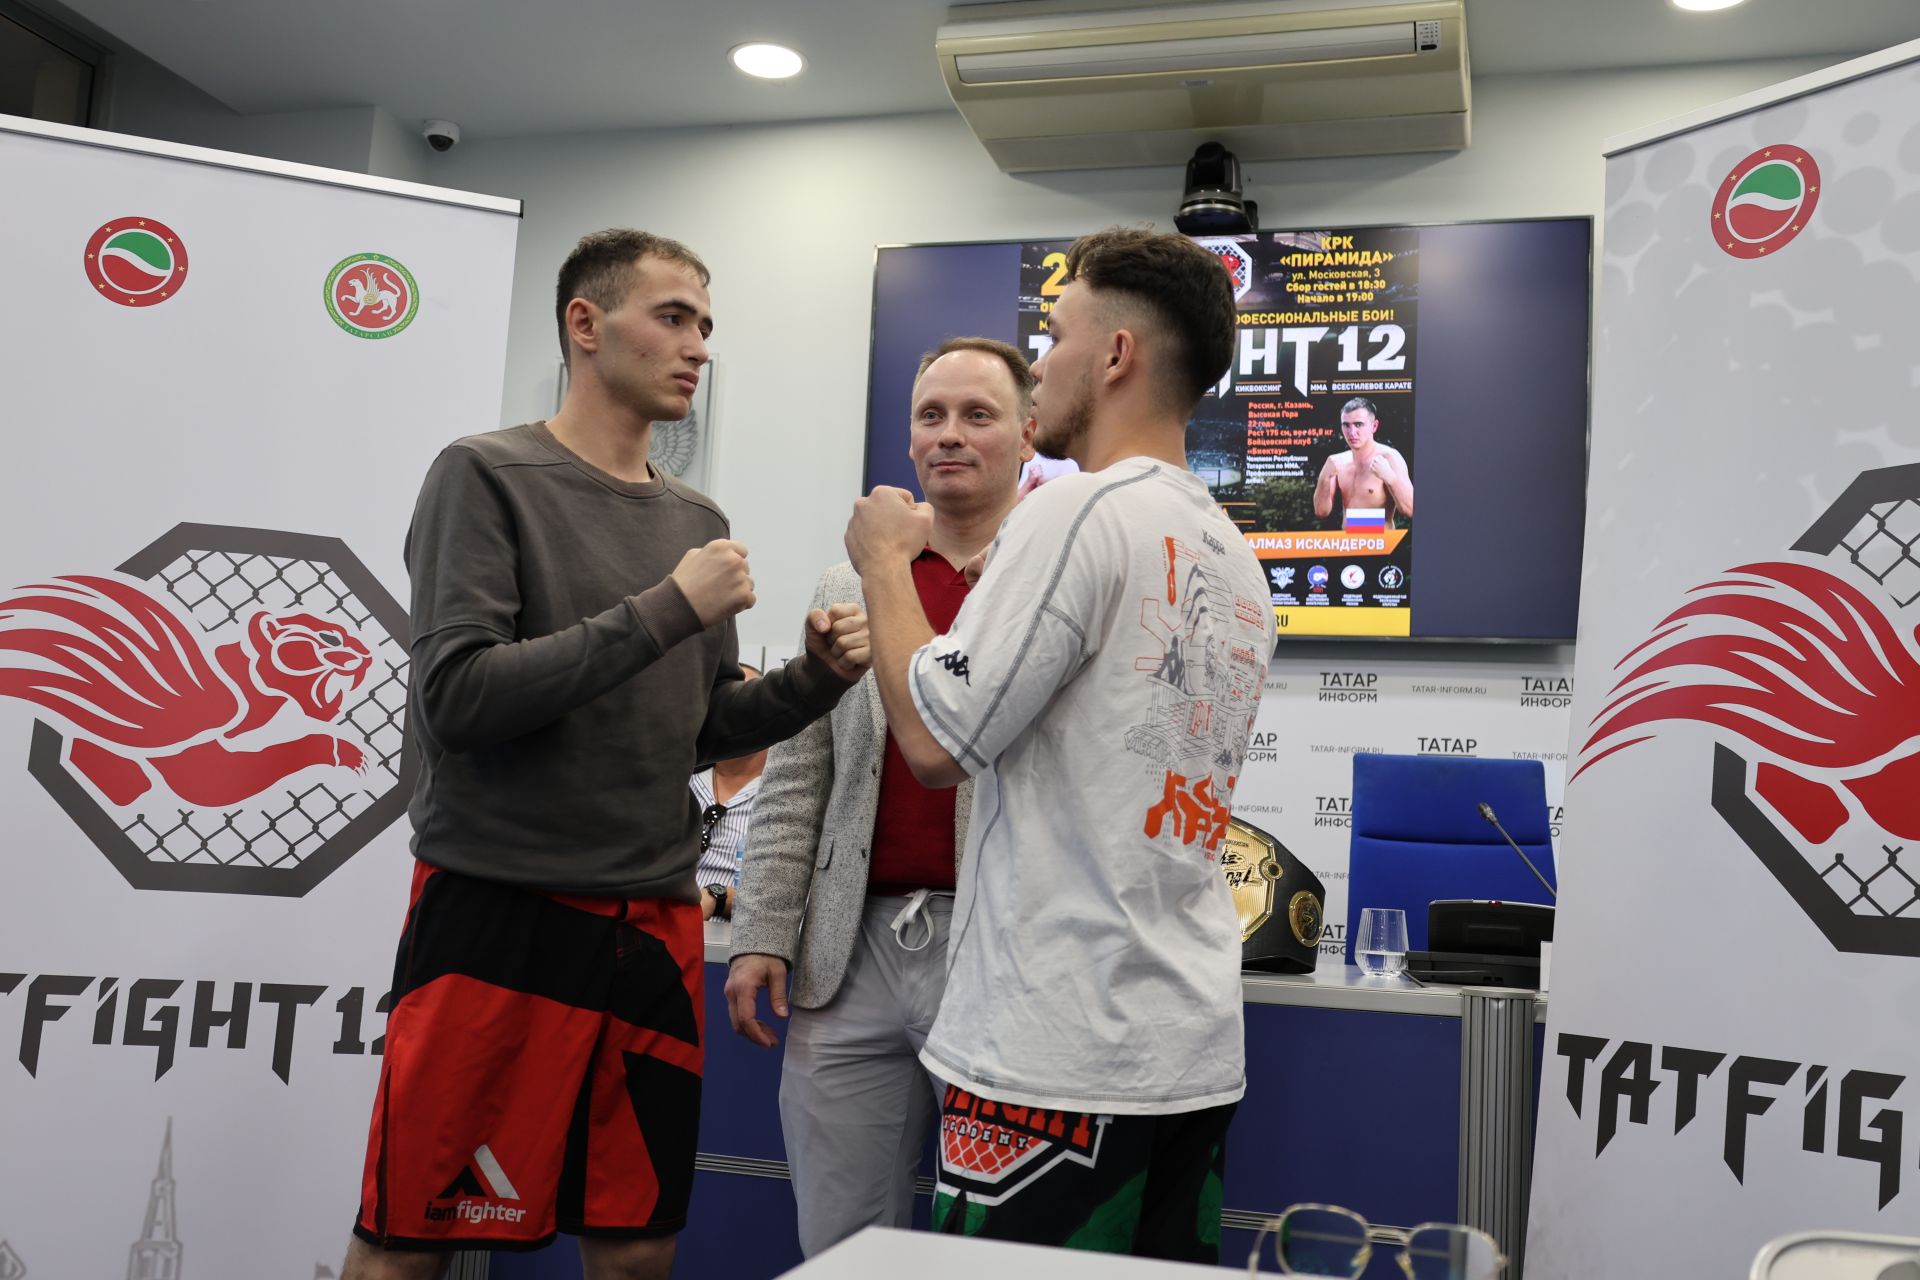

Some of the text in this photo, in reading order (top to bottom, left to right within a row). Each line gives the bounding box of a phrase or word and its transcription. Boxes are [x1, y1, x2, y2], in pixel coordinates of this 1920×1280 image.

[1321, 236, 1353, 250] КРК
[1280, 251, 1394, 267] «ПИРАМИДА»
[1292, 268, 1381, 281] ул. Московская, 3
[1286, 282, 1311, 293] Сбор
[1313, 280, 1347, 291] гостей
[1358, 280, 1386, 290] 18:30
[1297, 293, 1335, 304] Начало
[1346, 292, 1374, 302] 19:00
[1362, 310, 1394, 321] БОИ!
[1337, 324, 1406, 371] 12
[1235, 384, 1282, 393] КИКБОКСИНГ
[1332, 381, 1412, 391] ВСЕСТИЛЕВОЕ КАРАТЕ
[1248, 537, 1385, 552] АЛМАЗ ИСКАНДЕРОВ
[1320, 672, 1378, 688] ТАТАР
[1411, 685, 1487, 695] TATAR-INFORM.RU
[1319, 692, 1378, 703] ИНФОРМ
[1417, 737, 1477, 753] ТАТАР
[1557, 1032, 1920, 1212] TATFIG
[943, 1119, 1028, 1148] ACADEMY
[424, 1200, 527, 1224] iamfighter
